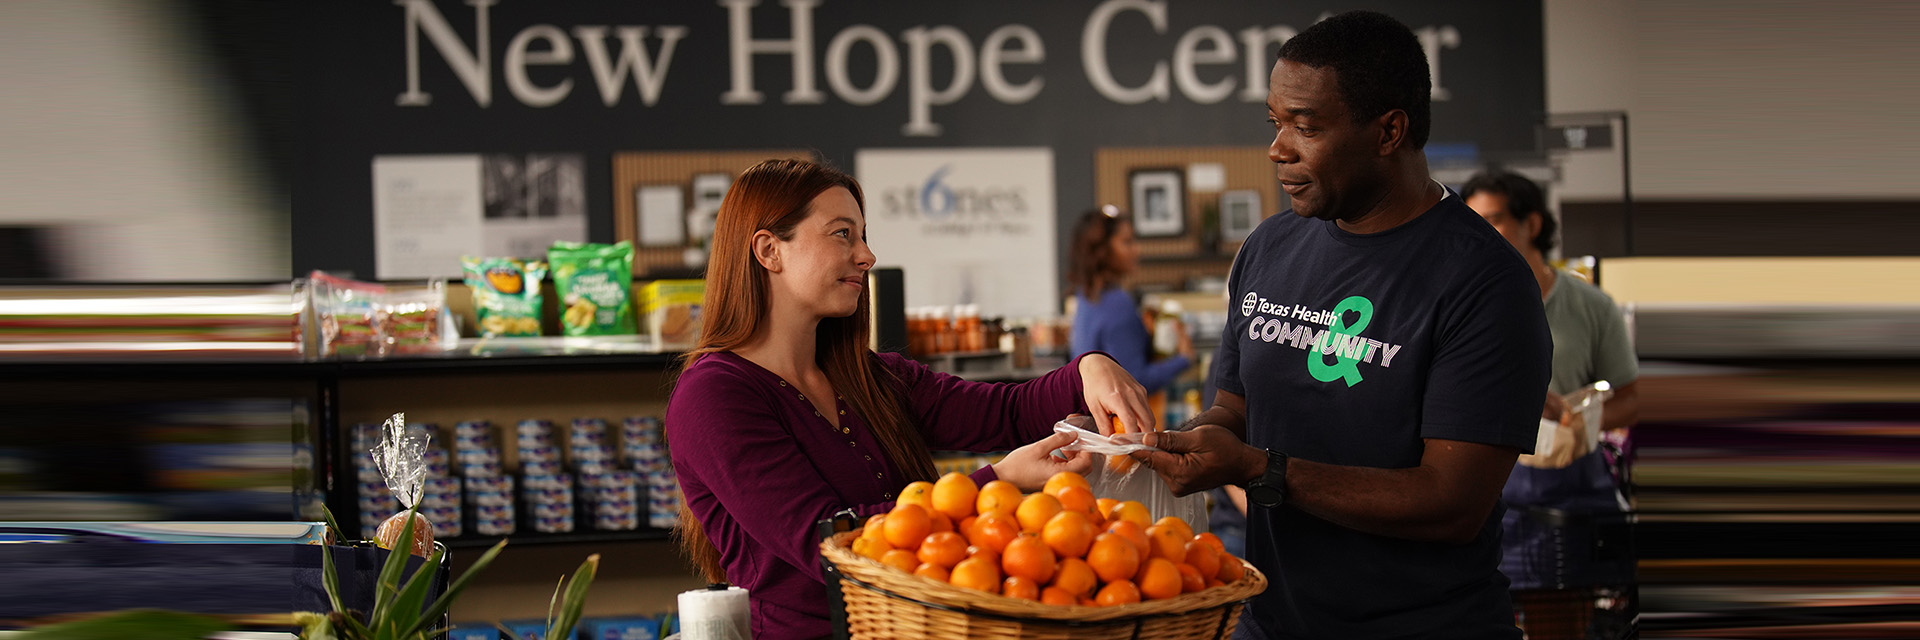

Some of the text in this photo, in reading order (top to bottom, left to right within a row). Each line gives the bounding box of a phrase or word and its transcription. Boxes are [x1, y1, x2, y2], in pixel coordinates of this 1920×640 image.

[396, 0, 1462, 137] New Hope Cenr
[1257, 298, 1338, 327] Texas Health
[1249, 316, 1402, 368] COMMUNITY
